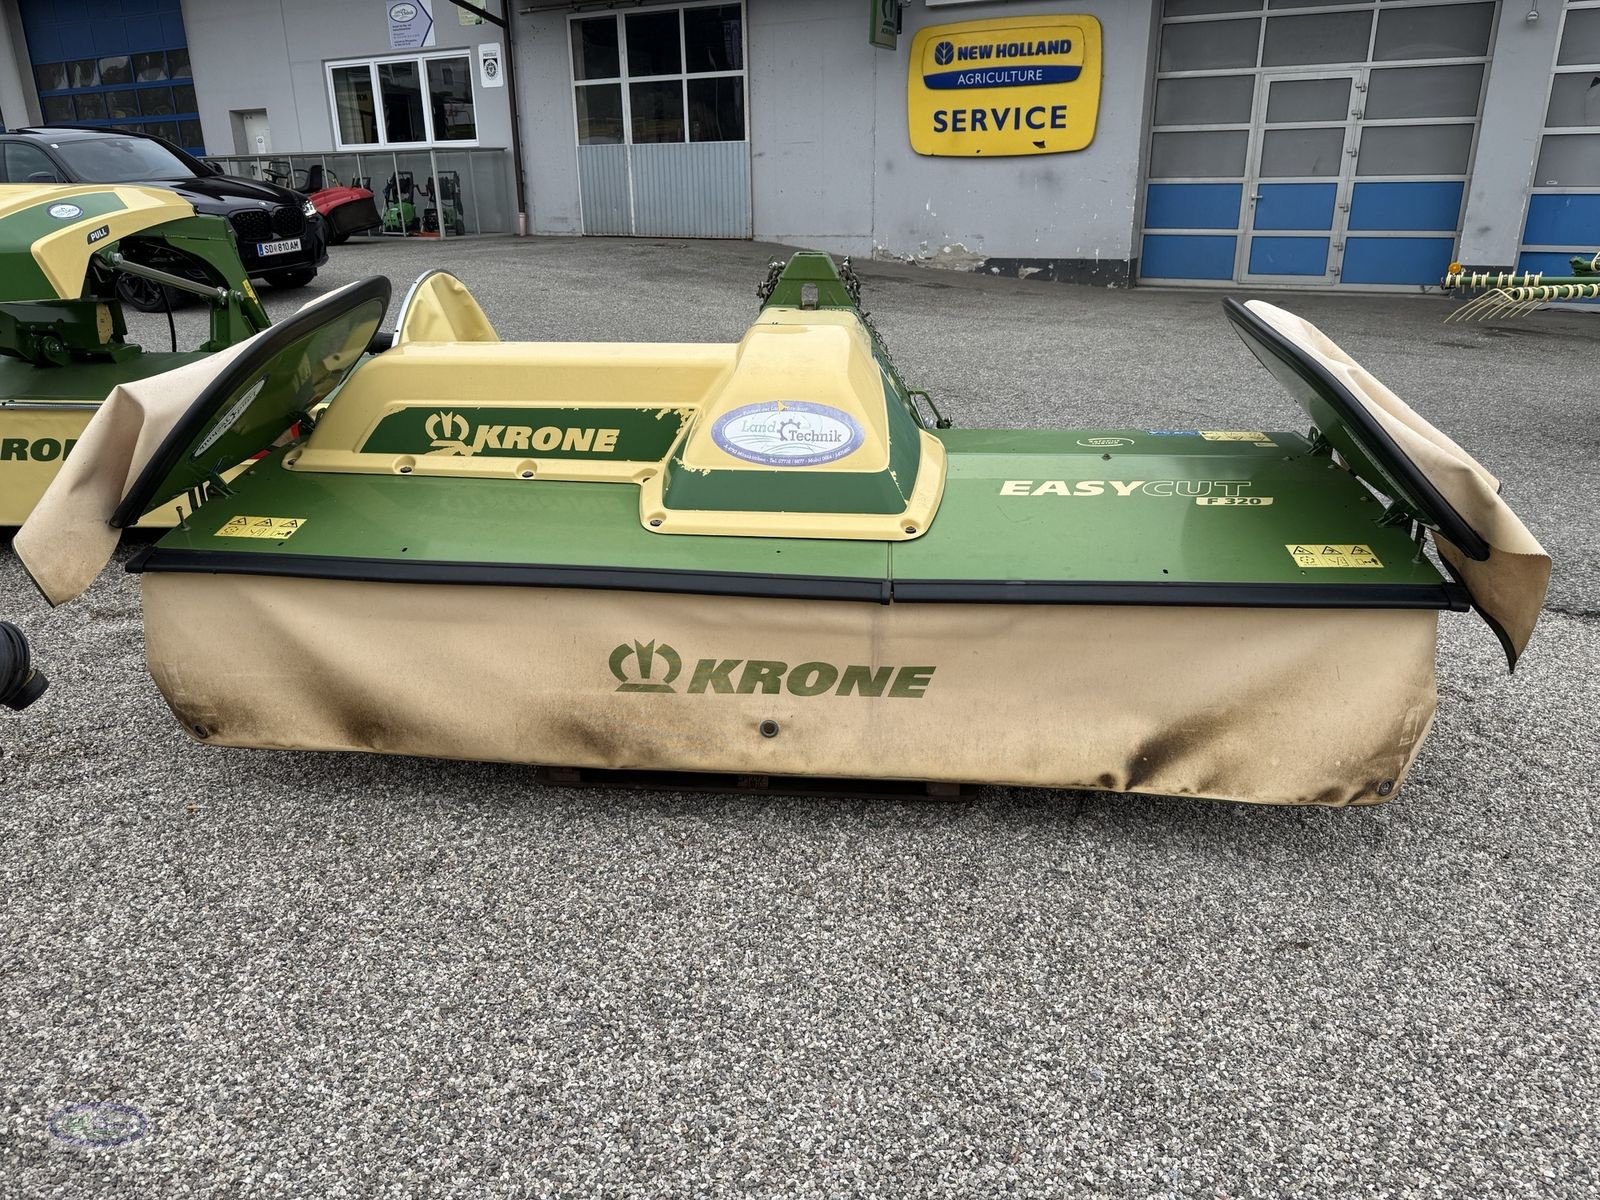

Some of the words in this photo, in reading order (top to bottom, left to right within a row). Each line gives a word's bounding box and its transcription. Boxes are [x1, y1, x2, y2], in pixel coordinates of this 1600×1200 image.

[957, 44, 993, 61] NEW
[995, 39, 1072, 58] HOLLAND
[957, 69, 1043, 85] AGRICULTURE
[933, 105, 1068, 133] SERVICE
[90, 228, 107, 241] PULL
[472, 425, 620, 453] KRONE
[741, 420, 777, 433] Land
[788, 429, 842, 443] Technik
[1224, 497, 1262, 505] 320
[687, 658, 937, 699] KRONE
